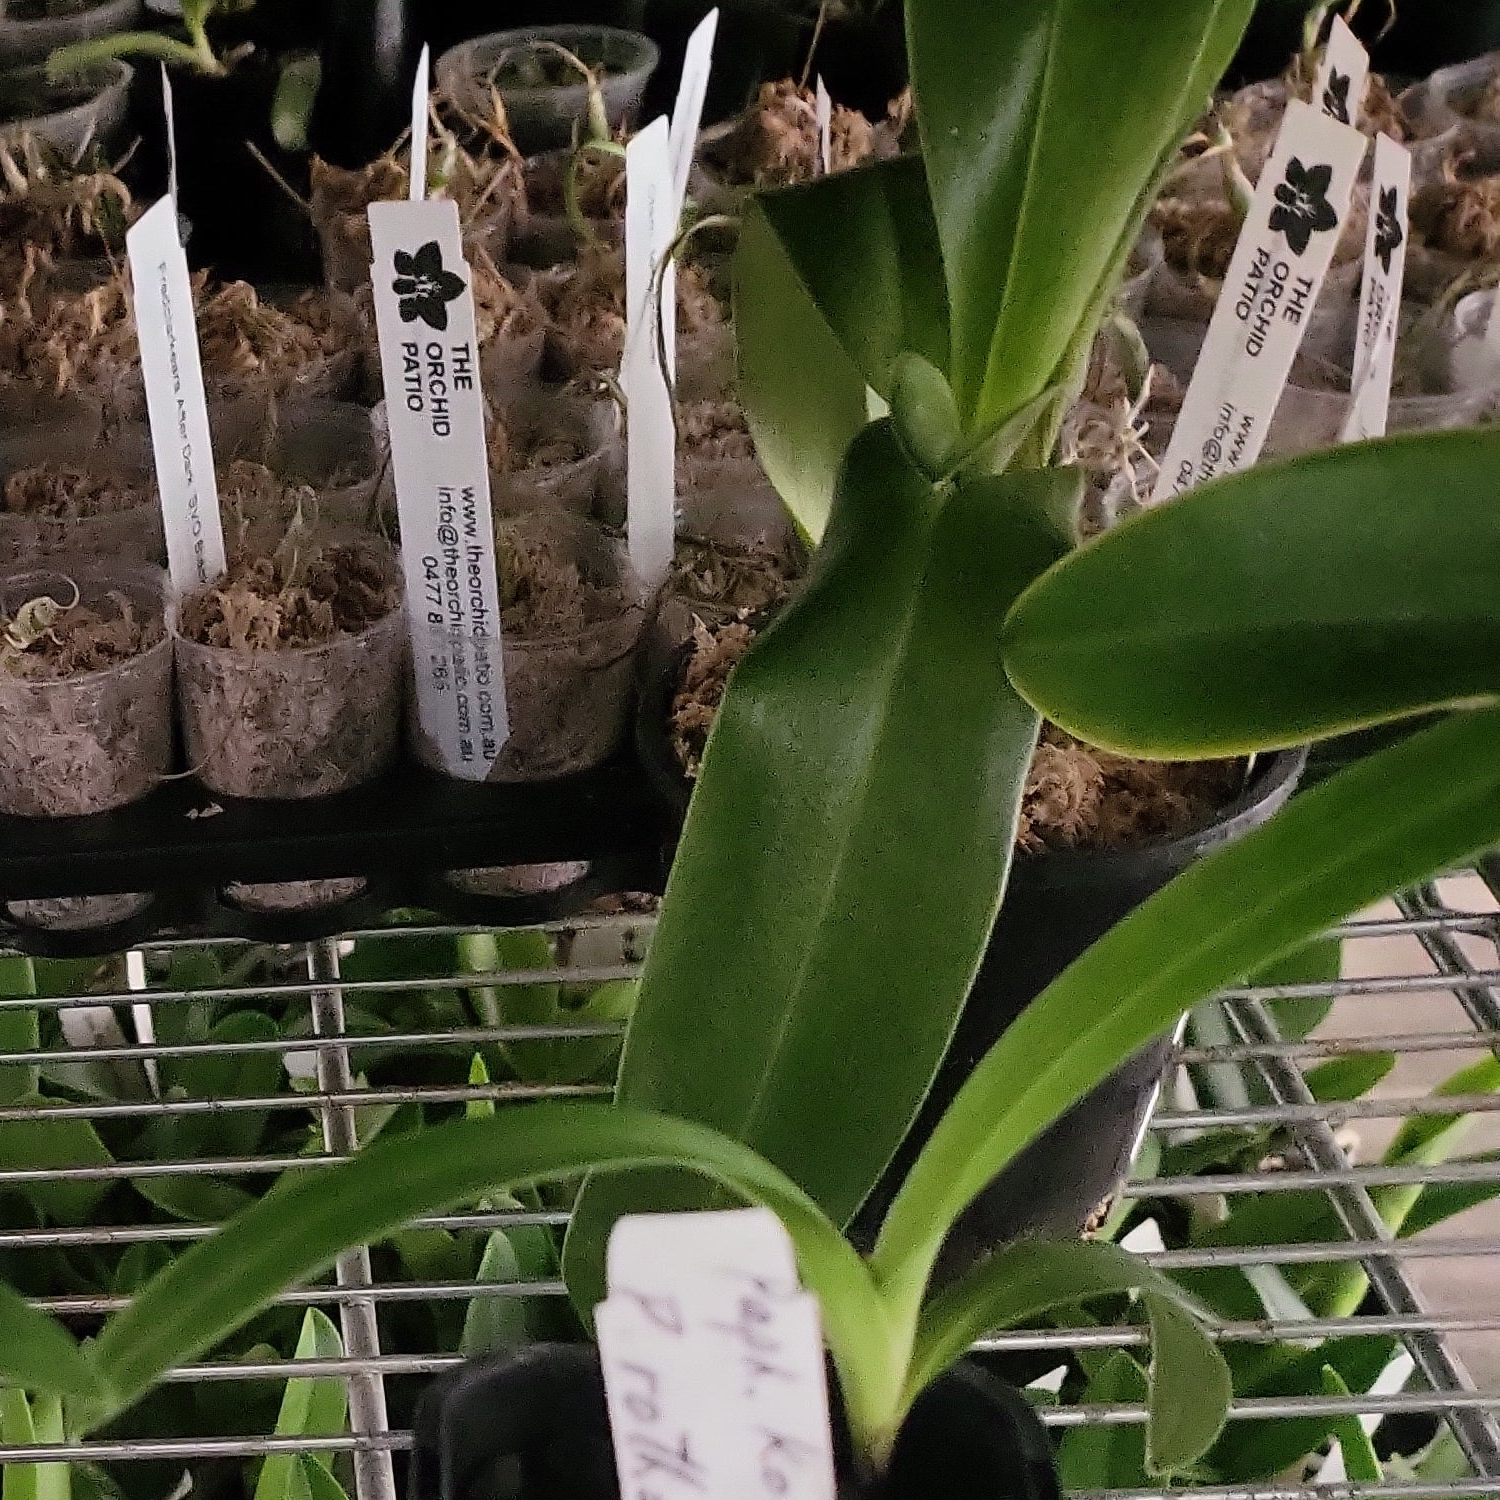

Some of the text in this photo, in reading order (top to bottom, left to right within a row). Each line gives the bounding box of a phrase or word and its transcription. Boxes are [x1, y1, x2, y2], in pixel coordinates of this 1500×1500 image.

[1235, 245, 1271, 322] PATIO
[1245, 260, 1291, 359] ORCHID
[1282, 276, 1314, 326] THE
[400, 341, 425, 413] PATIO
[425, 340, 451, 438] ORCHID
[451, 341, 474, 391] THE
[421, 555, 444, 607] 0477
[460, 485, 496, 761] www.theorchidatiocom.au
